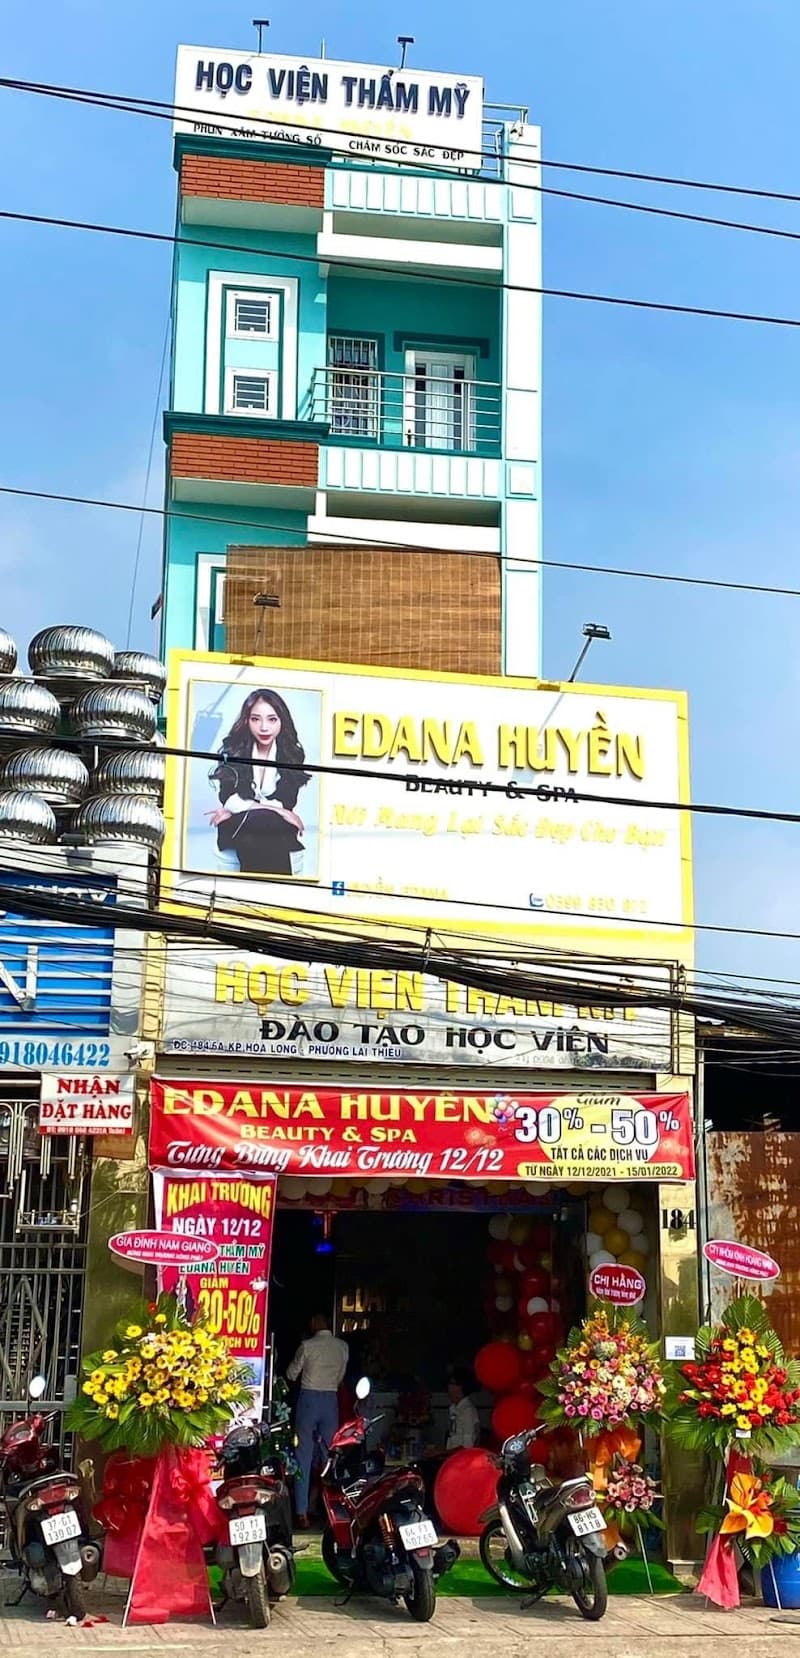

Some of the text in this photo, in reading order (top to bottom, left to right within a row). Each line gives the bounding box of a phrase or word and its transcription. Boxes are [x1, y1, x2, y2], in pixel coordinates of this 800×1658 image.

[196, 60, 470, 118] HỌC VIỆN THẨM MỸ
[332, 710, 646, 781] EDANA HUYỀN
[214, 961, 308, 1016] HỌC
[259, 1014, 339, 1042] ĐÀO
[353, 1023, 425, 1048] TẠO
[446, 1026, 516, 1054] HỌC
[271, 1044, 297, 1055] LONG
[57, 1075, 120, 1099] NHẬN
[42, 1099, 132, 1122] ĐẶT HÀNG
[163, 1088, 326, 1119] EDANA
[240, 1126, 417, 1143] BEAUTY & SPA
[514, 1106, 584, 1143] 30%
[611, 1109, 680, 1145] 50%
[299, 1144, 352, 1169] Khai
[440, 1146, 504, 1173] 12/12
[610, 1149, 633, 1164] DỊCH
[539, 1163, 564, 1176] NGÀY
[567, 1166, 616, 1177] 12/12/2021
[628, 1166, 678, 1177] 15/01/2022
[167, 1182, 206, 1217] KHAI
[172, 1213, 261, 1237] NGÀY 12/12
[660, 1208, 695, 1229] 184
[116, 1236, 132, 1247] GIA
[159, 1239, 179, 1250] NAM
[181, 1241, 212, 1254] GIANG
